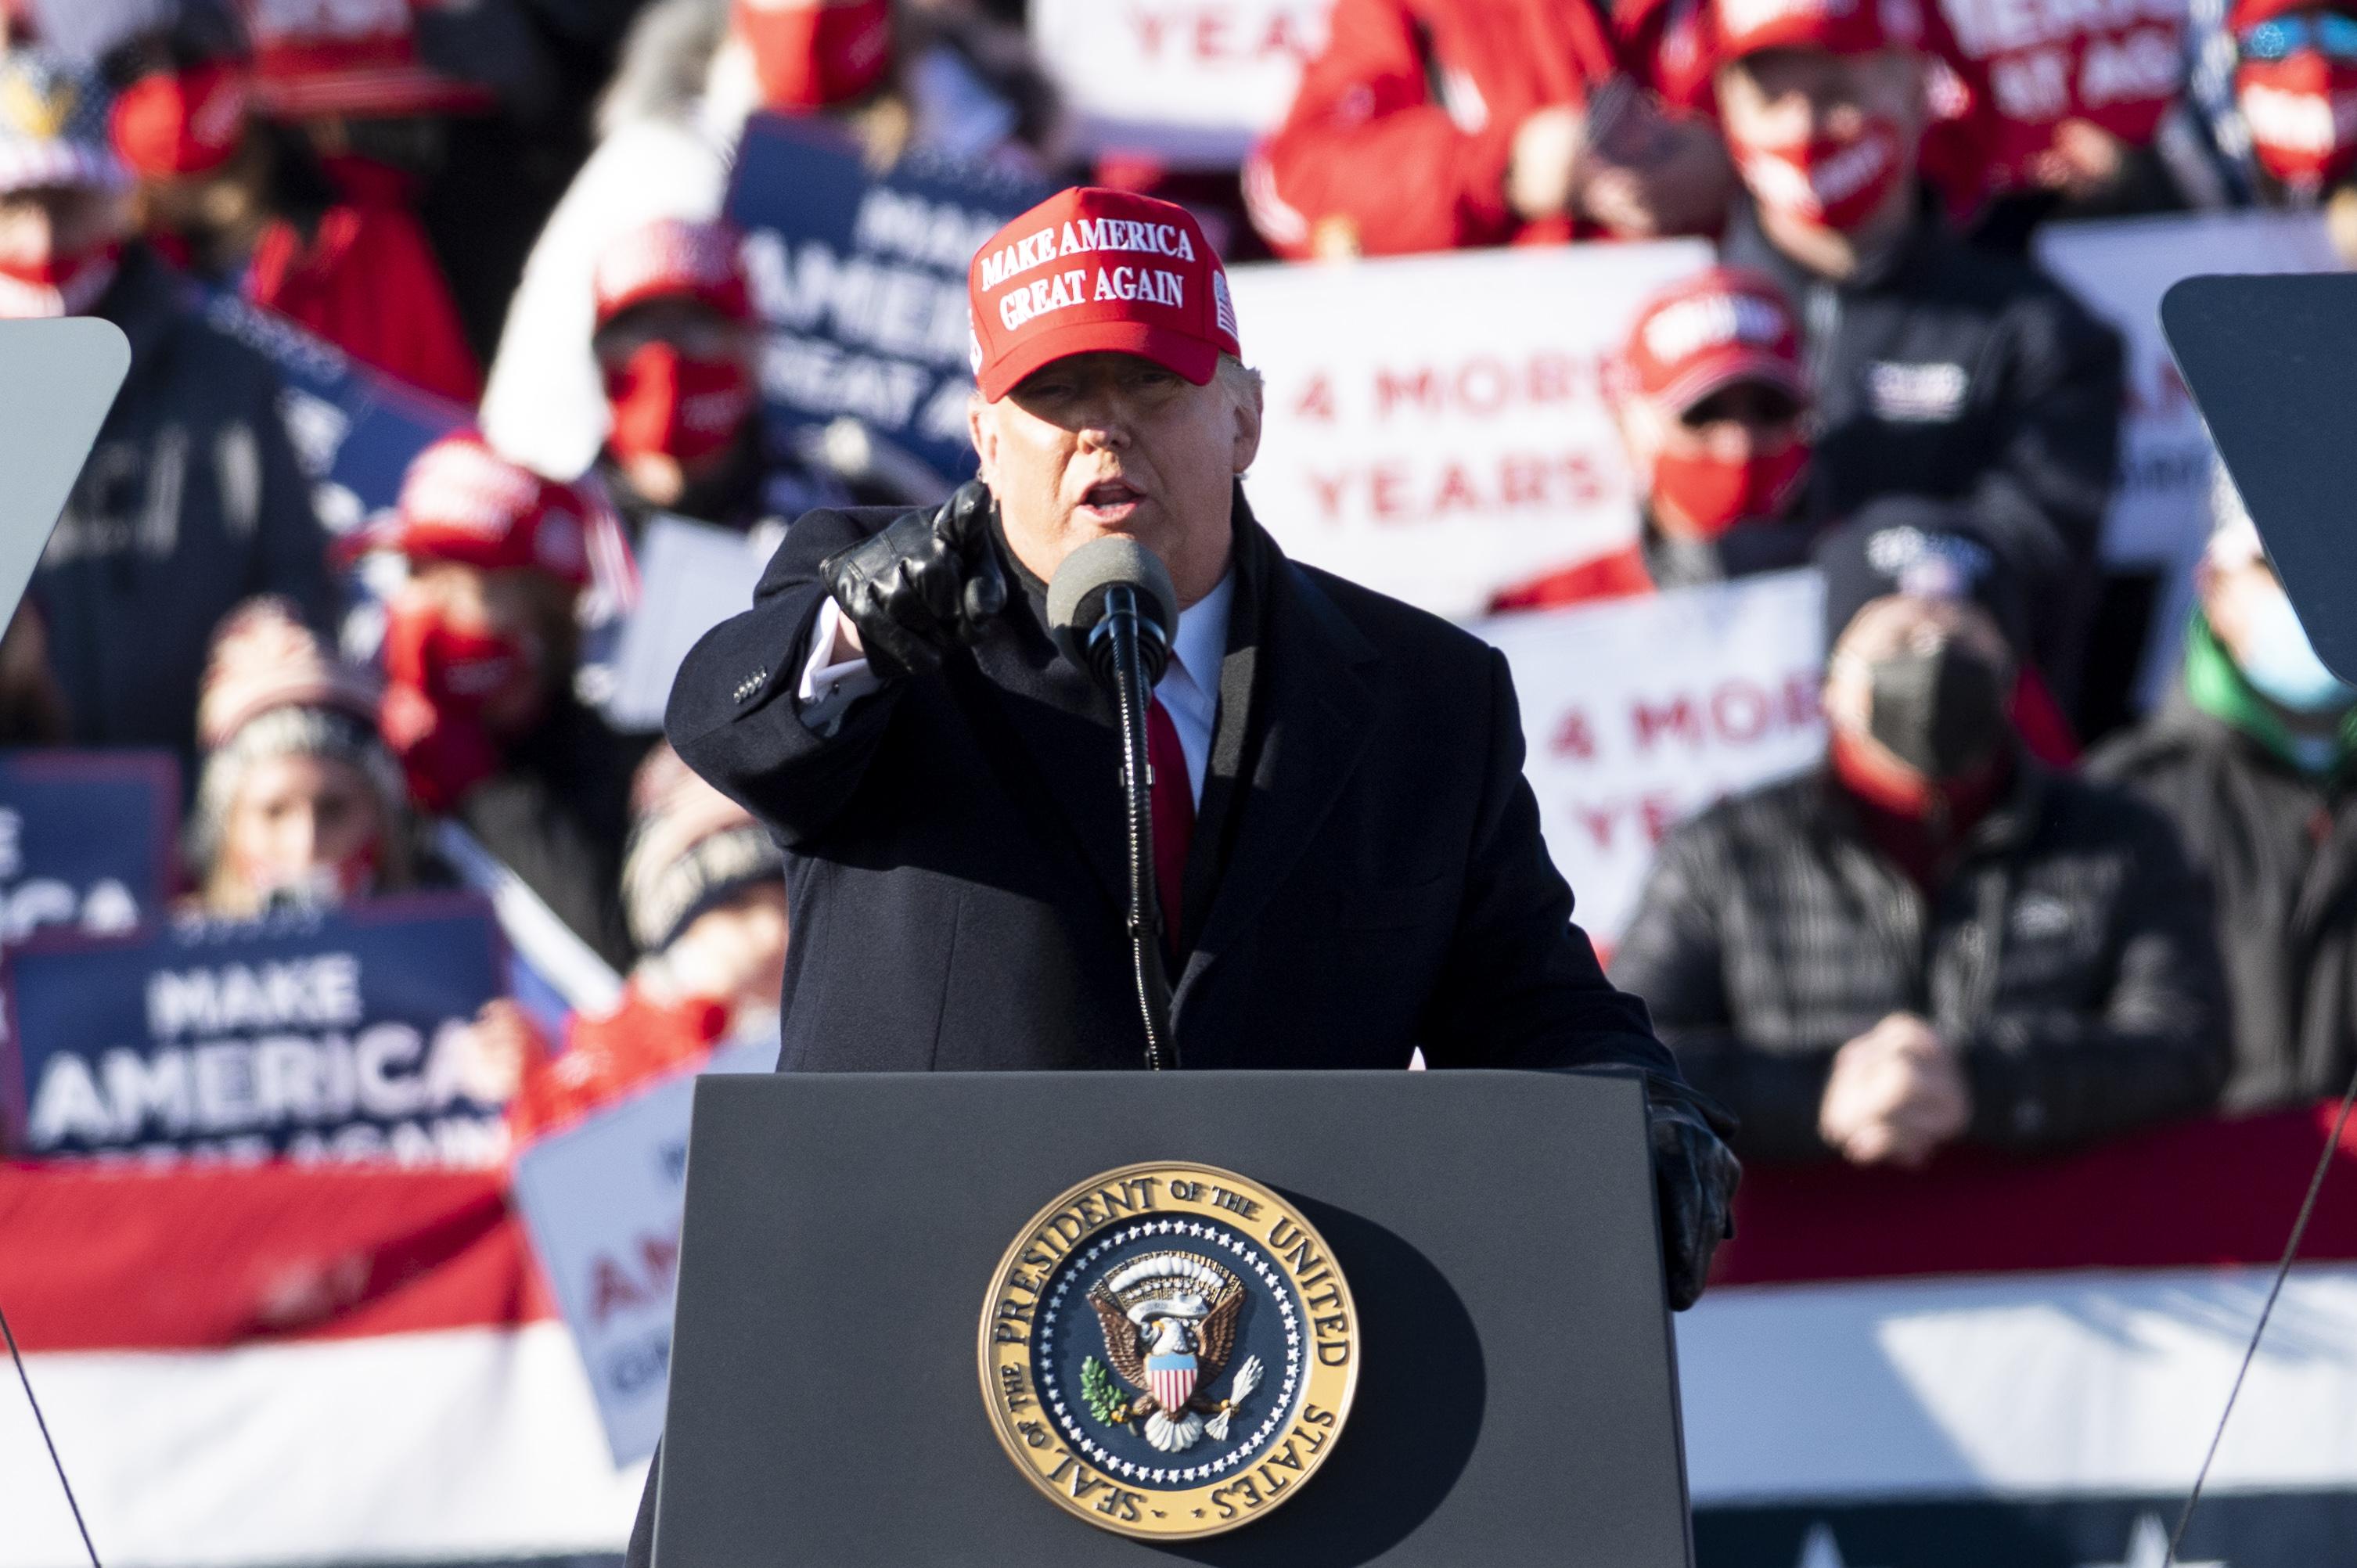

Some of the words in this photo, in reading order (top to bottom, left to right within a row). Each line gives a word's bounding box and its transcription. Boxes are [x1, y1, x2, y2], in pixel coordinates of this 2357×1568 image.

[1127, 3, 1303, 64] YEA
[981, 227, 1057, 292] MAKE
[1059, 217, 1196, 263] AMERICA
[999, 268, 1087, 332] GREAT
[1093, 266, 1185, 309] AGAIN
[1290, 368, 1335, 423] 4
[1301, 450, 1608, 526] YEARS
[1546, 696, 1598, 765] 4
[1628, 673, 1825, 757] MOR
[147, 952, 363, 1037] MAKE
[1170, 1179, 1200, 1202] OF
[1211, 1184, 1263, 1221] THE
[995, 1177, 1154, 1347] PRESIDENT
[1267, 1216, 1349, 1367] UNITED
[1001, 1362, 1022, 1412] THE
[1017, 1420, 1047, 1448] OF
[1211, 1404, 1335, 1519] STATES
[1049, 1444, 1145, 1522] SEAL
